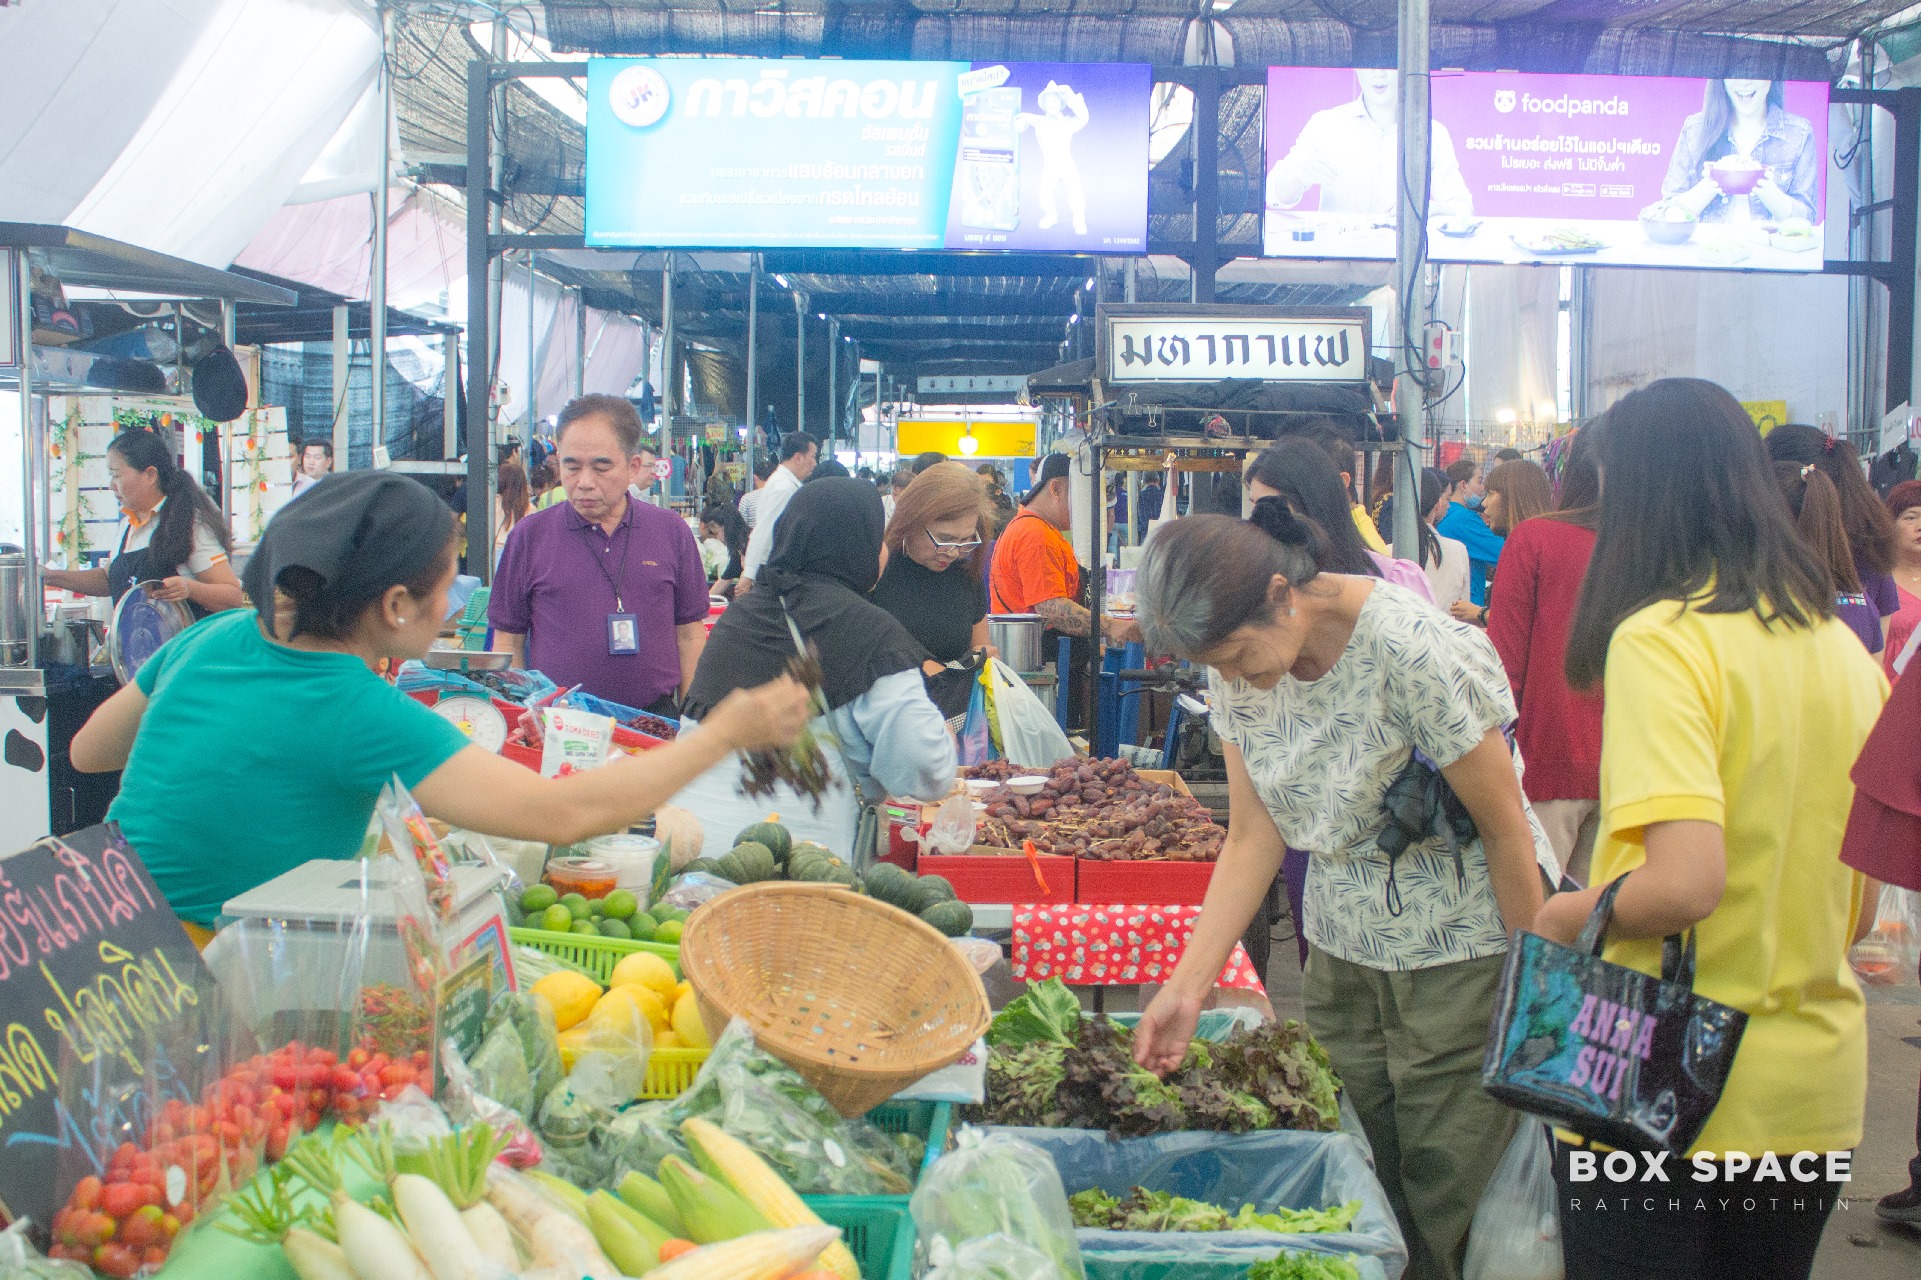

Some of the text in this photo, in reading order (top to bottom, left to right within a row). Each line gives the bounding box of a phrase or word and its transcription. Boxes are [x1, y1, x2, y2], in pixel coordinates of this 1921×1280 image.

[685, 69, 938, 119] กาวิสคอน
[1521, 93, 1629, 118] foodpanda
[1120, 329, 1349, 367] มหากาแฟ
[1568, 993, 1658, 1060] ANNA
[1568, 1043, 1629, 1100] SUI
